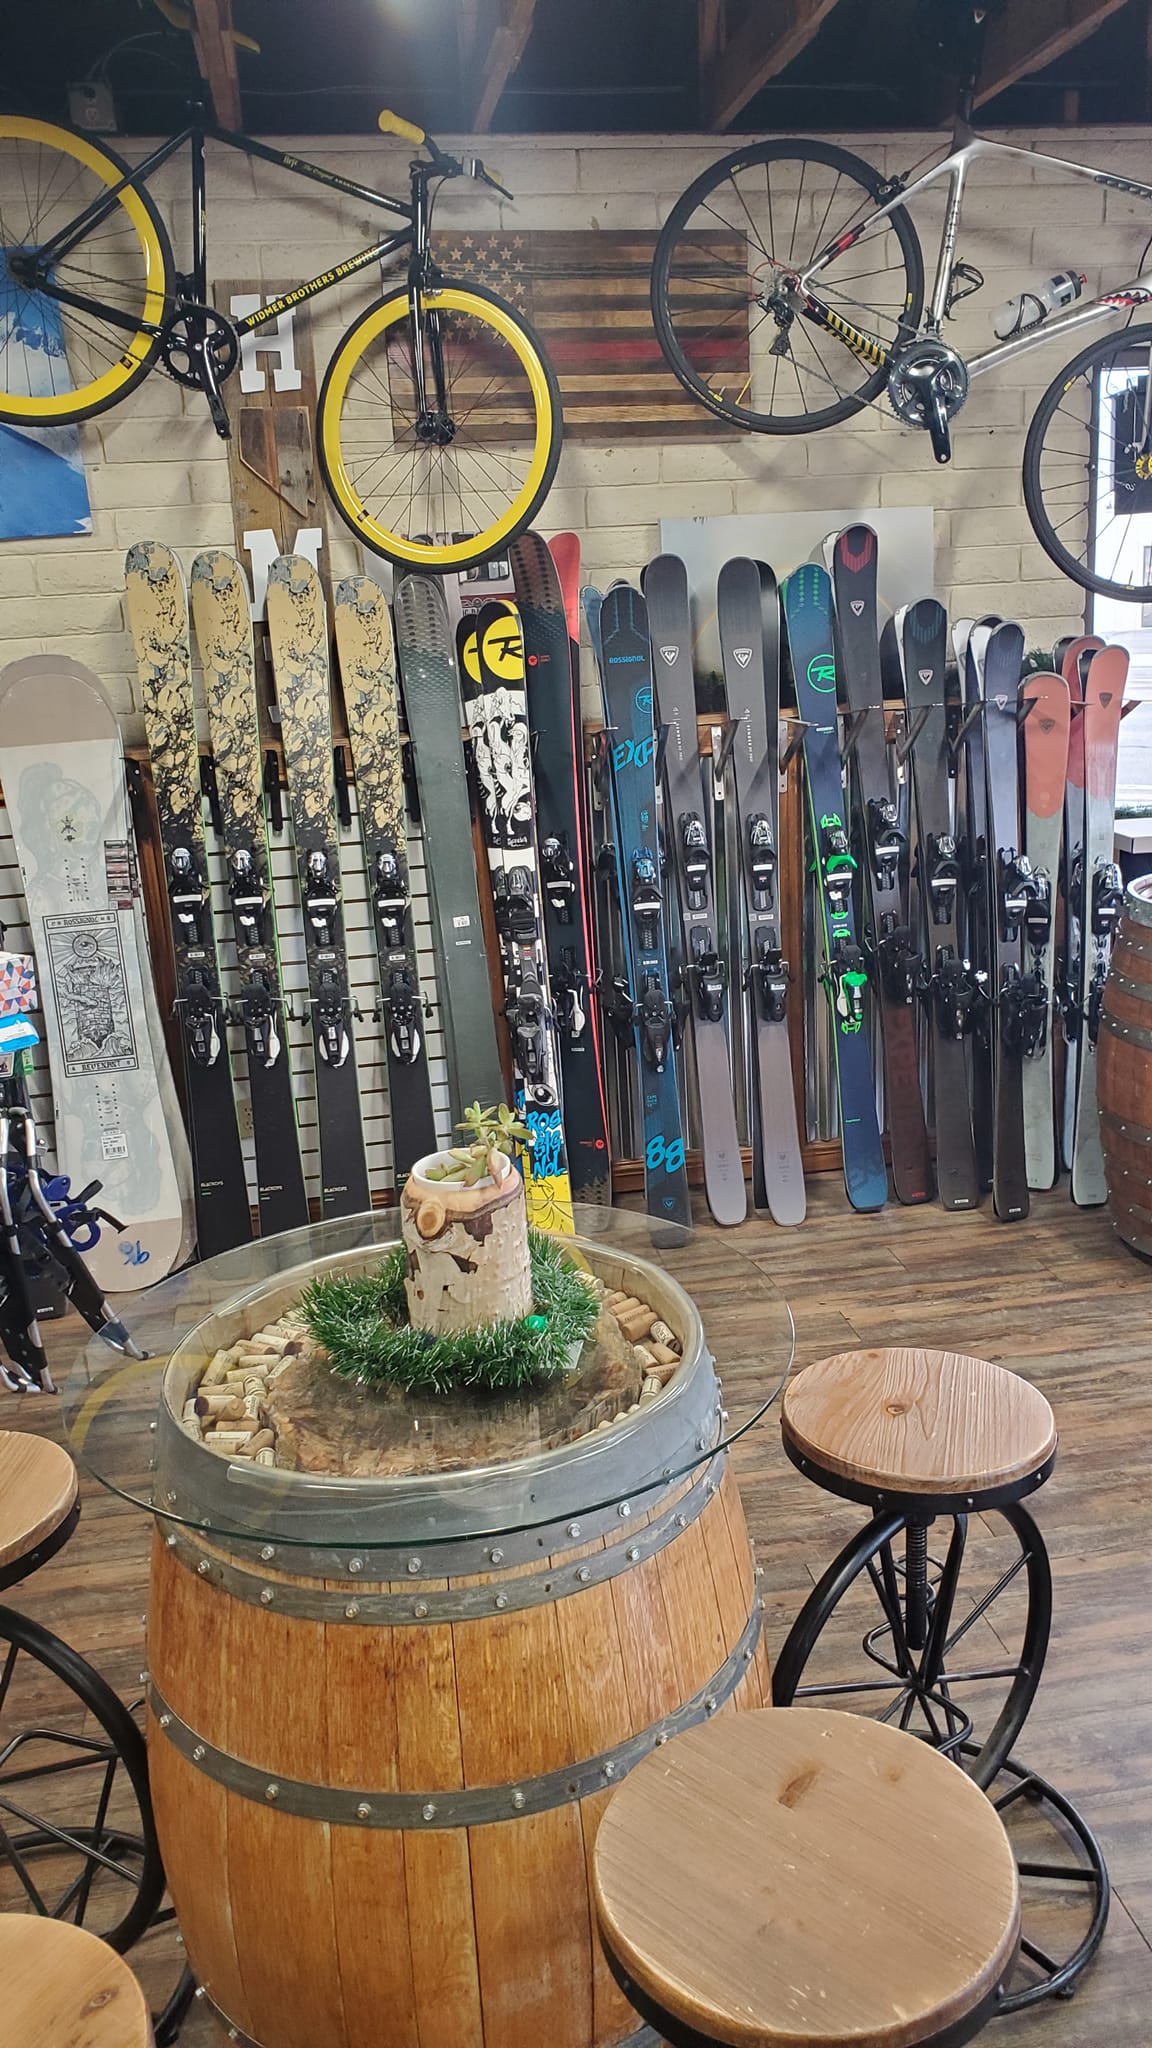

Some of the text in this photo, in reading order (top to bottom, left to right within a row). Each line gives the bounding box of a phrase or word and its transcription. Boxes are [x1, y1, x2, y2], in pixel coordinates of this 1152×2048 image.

[245, 246, 380, 327] WIDMER BROTHERS BREWING
[230, 293, 302, 393] H
[609, 655, 646, 664] ROSSIGNOL
[646, 1135, 686, 1174] 88
